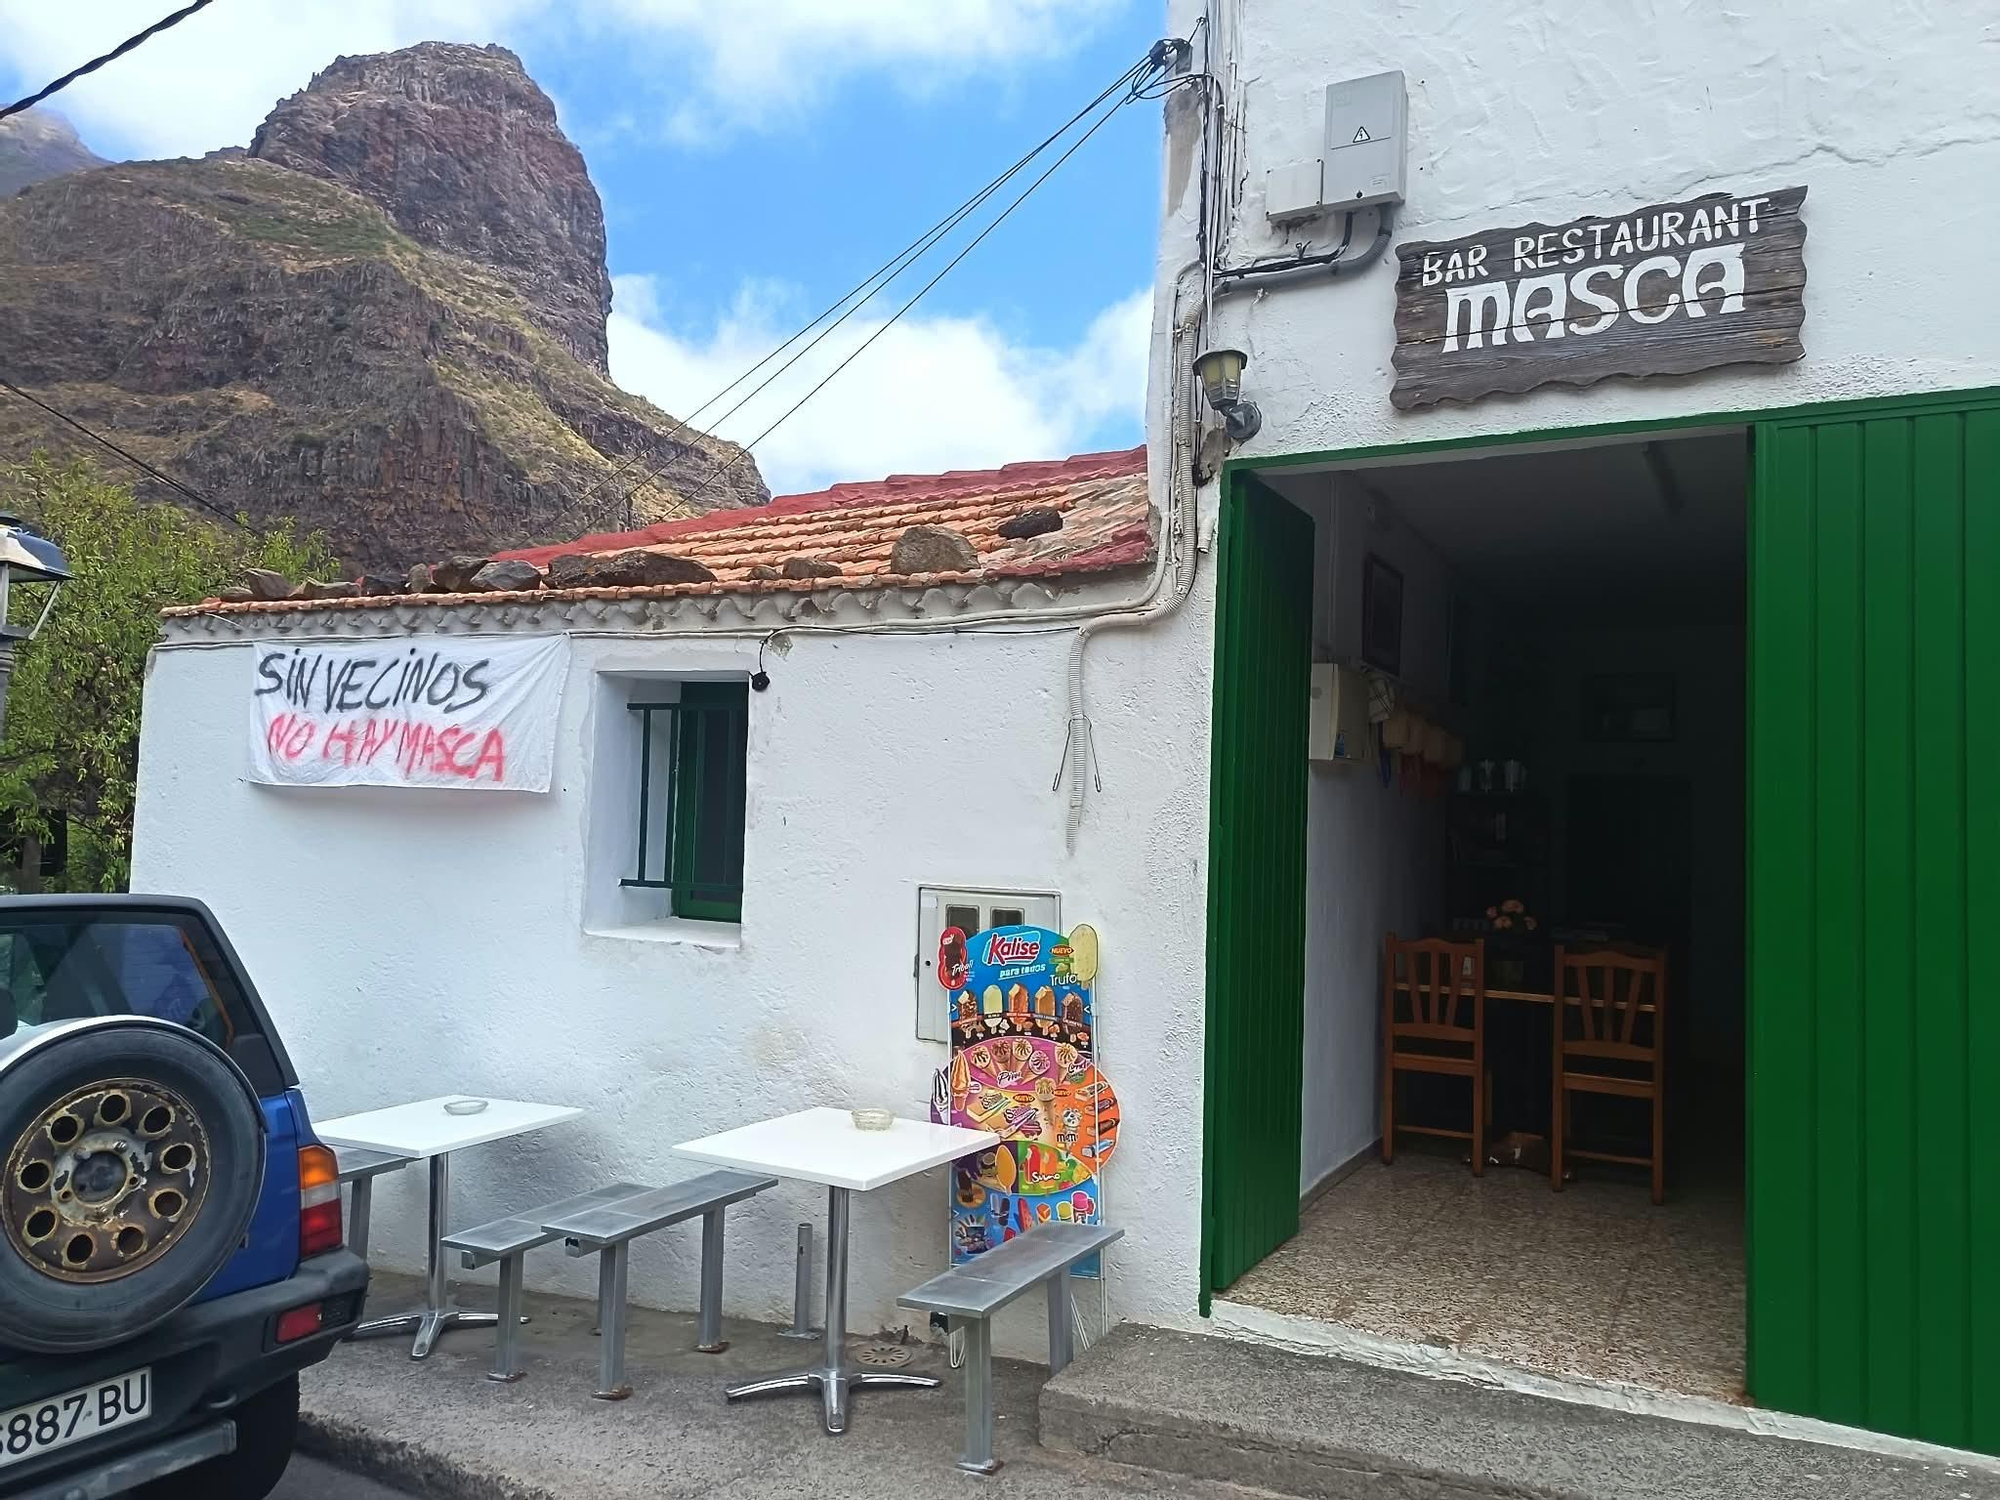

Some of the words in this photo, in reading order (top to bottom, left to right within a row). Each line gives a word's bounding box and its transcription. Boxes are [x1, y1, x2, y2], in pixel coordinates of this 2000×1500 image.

[1421, 243, 1490, 287] BAR
[1513, 197, 1770, 274] RESTAURANT
[1441, 241, 1747, 354] MASCA
[267, 713, 316, 759] NO
[322, 718, 398, 766] HAY
[396, 721, 504, 782] MASCA
[987, 933, 1040, 965] Kalise
[1000, 967, 1020, 979] para
[1051, 946, 1072, 954] NUEVO
[0, 1392, 88, 1455] 887
